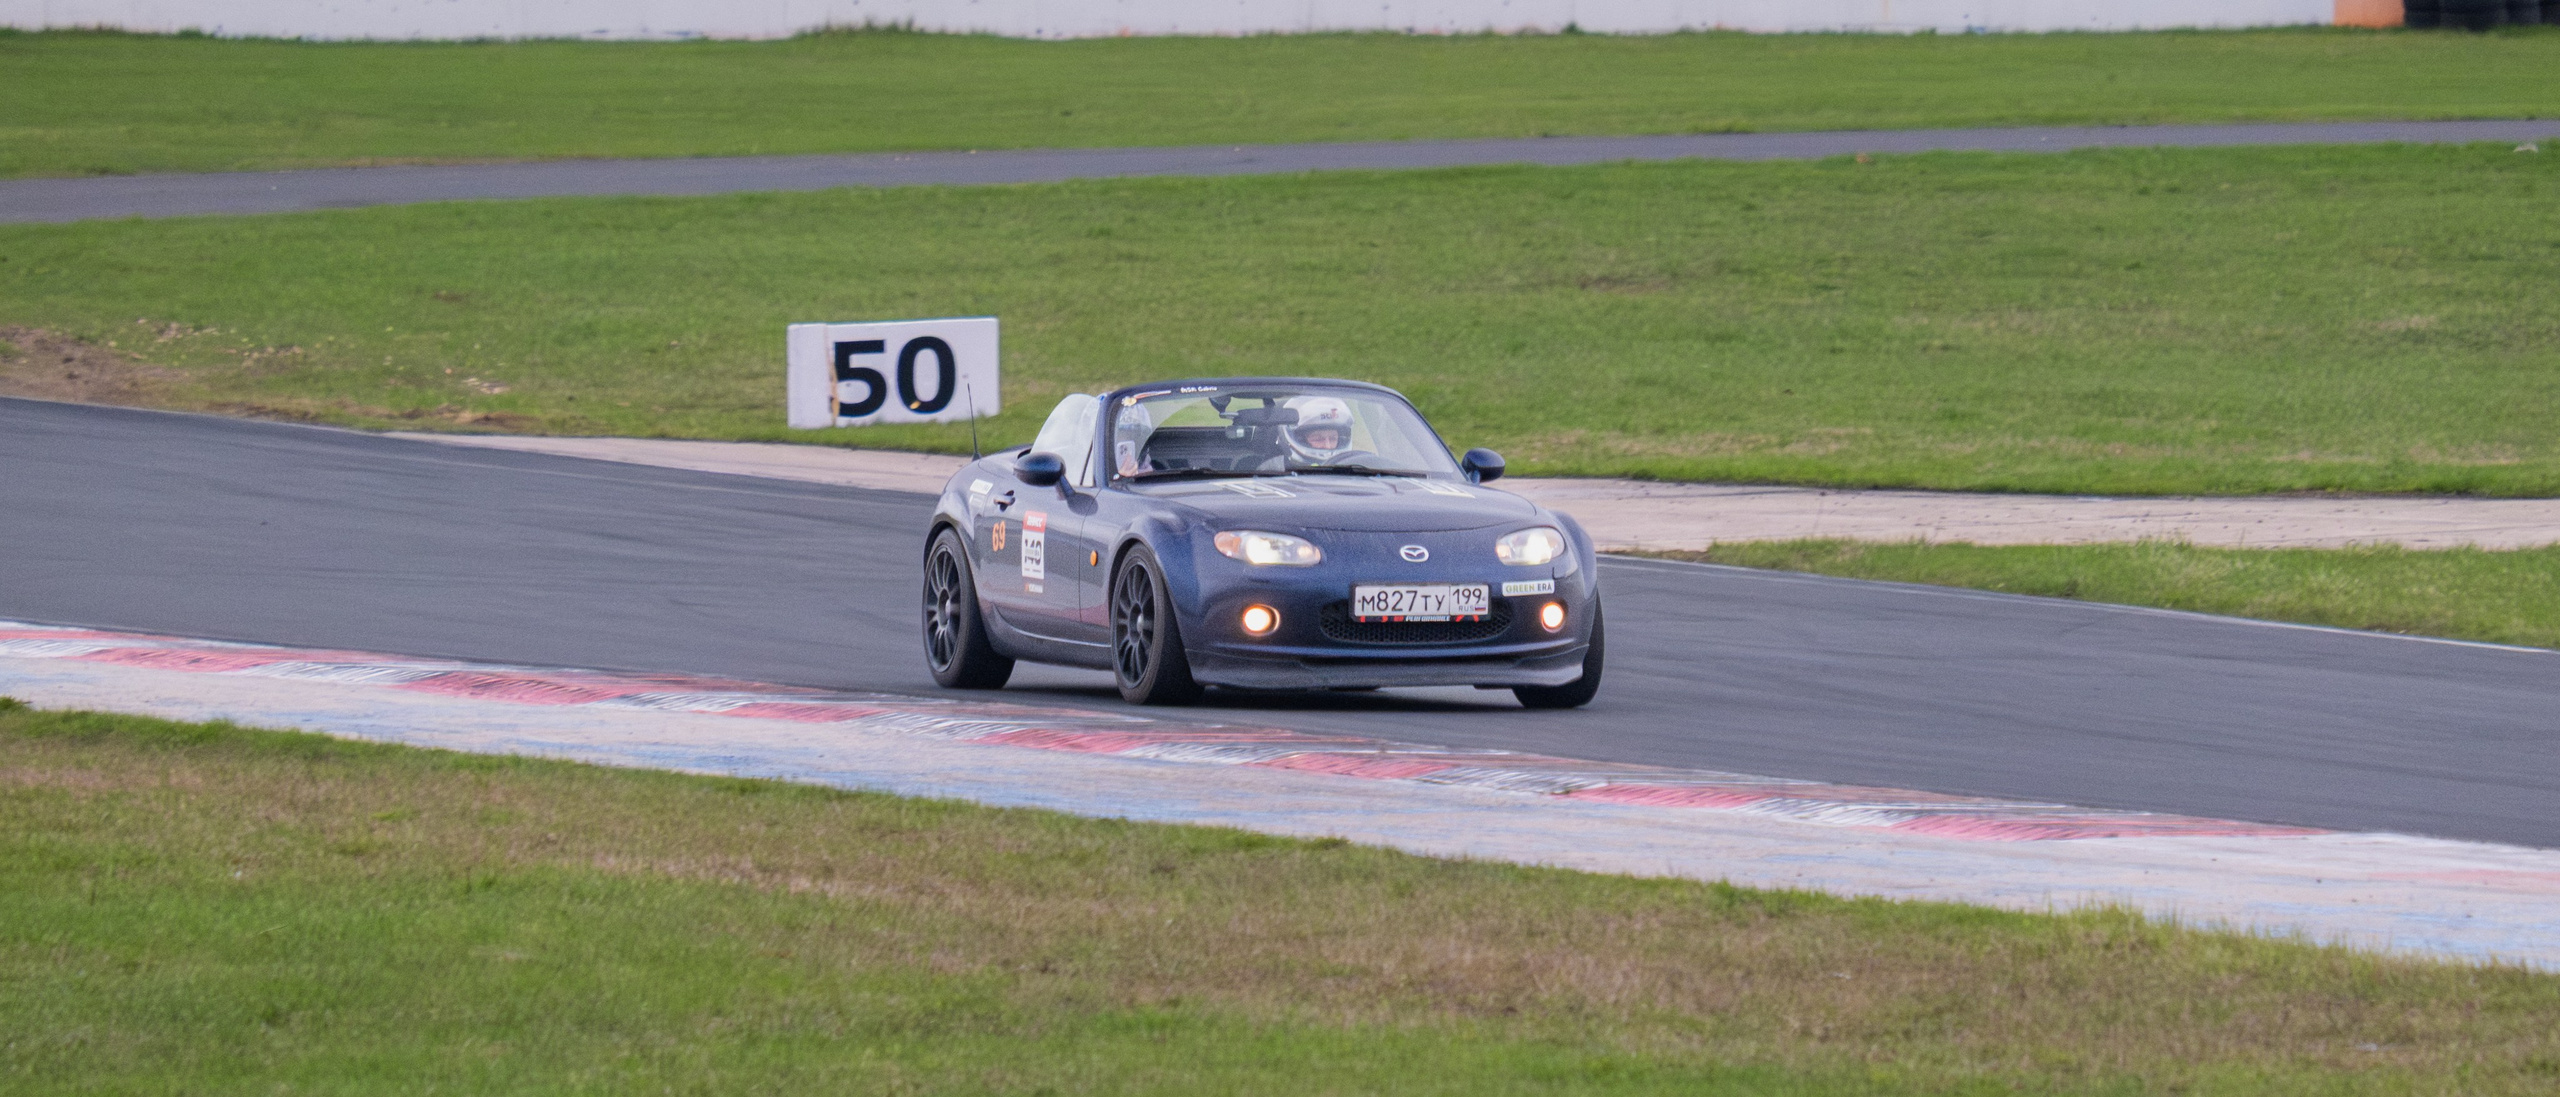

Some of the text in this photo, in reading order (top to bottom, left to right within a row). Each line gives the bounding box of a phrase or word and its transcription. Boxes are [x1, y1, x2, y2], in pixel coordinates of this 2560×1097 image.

[833, 335, 956, 417] 50
[992, 520, 1006, 552] 69
[1452, 588, 1482, 605] 199
[1537, 582, 1553, 592] ERA
